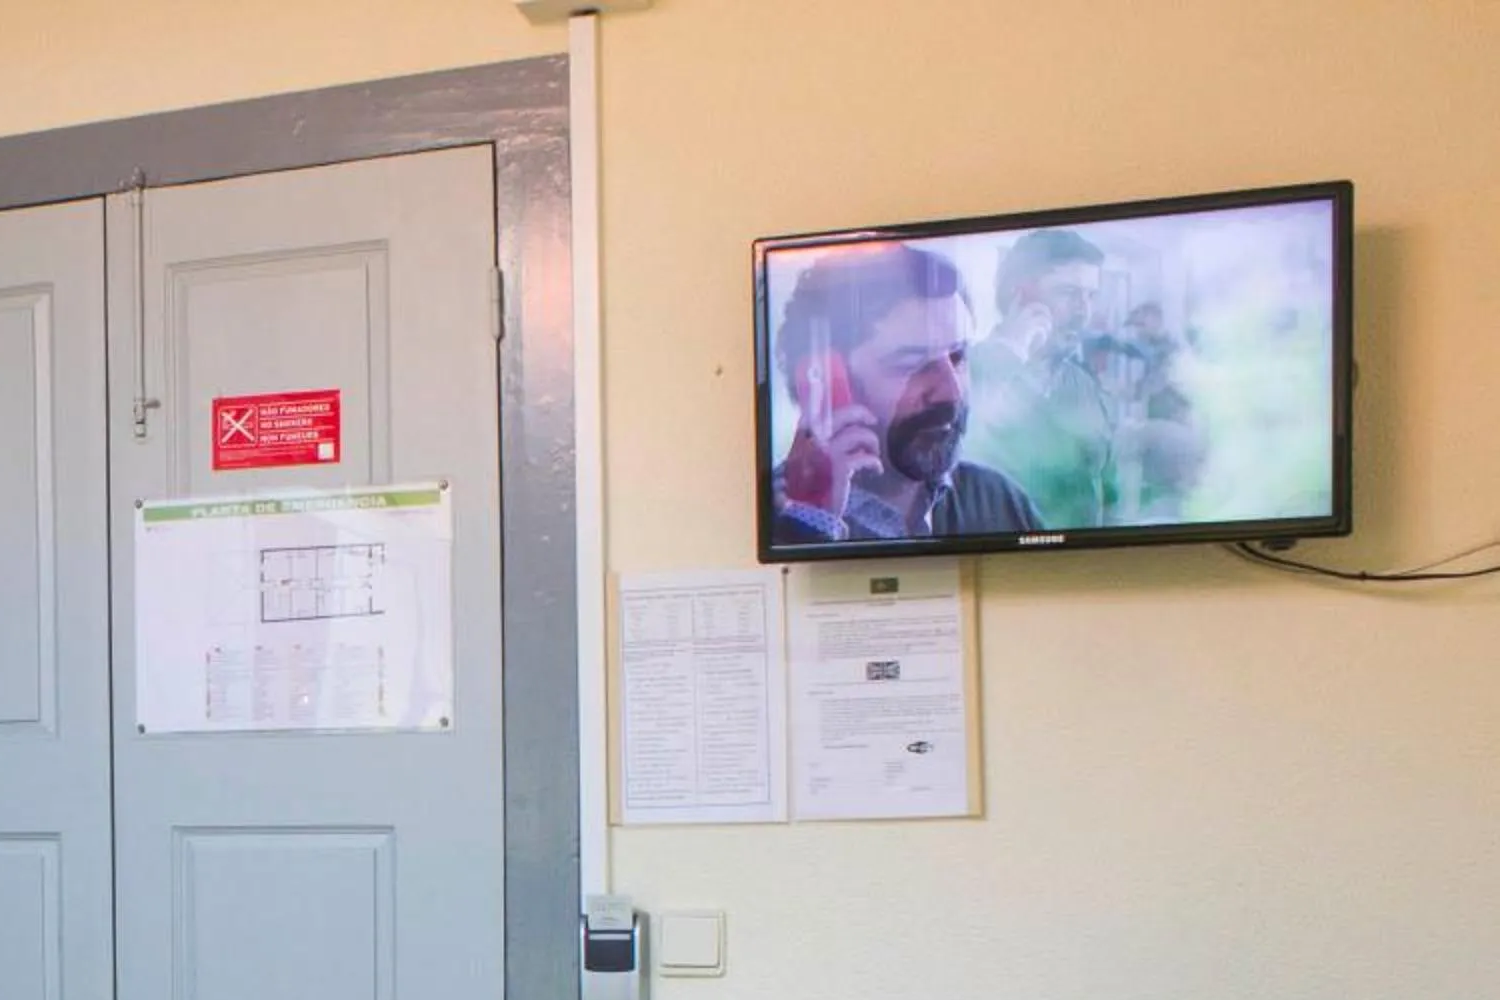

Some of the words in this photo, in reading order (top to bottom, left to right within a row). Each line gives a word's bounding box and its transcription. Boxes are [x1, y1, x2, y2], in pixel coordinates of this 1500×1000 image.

[191, 503, 250, 518] PLANTA
[255, 500, 276, 514] DE
[1019, 534, 1065, 545] SAMSUNG
